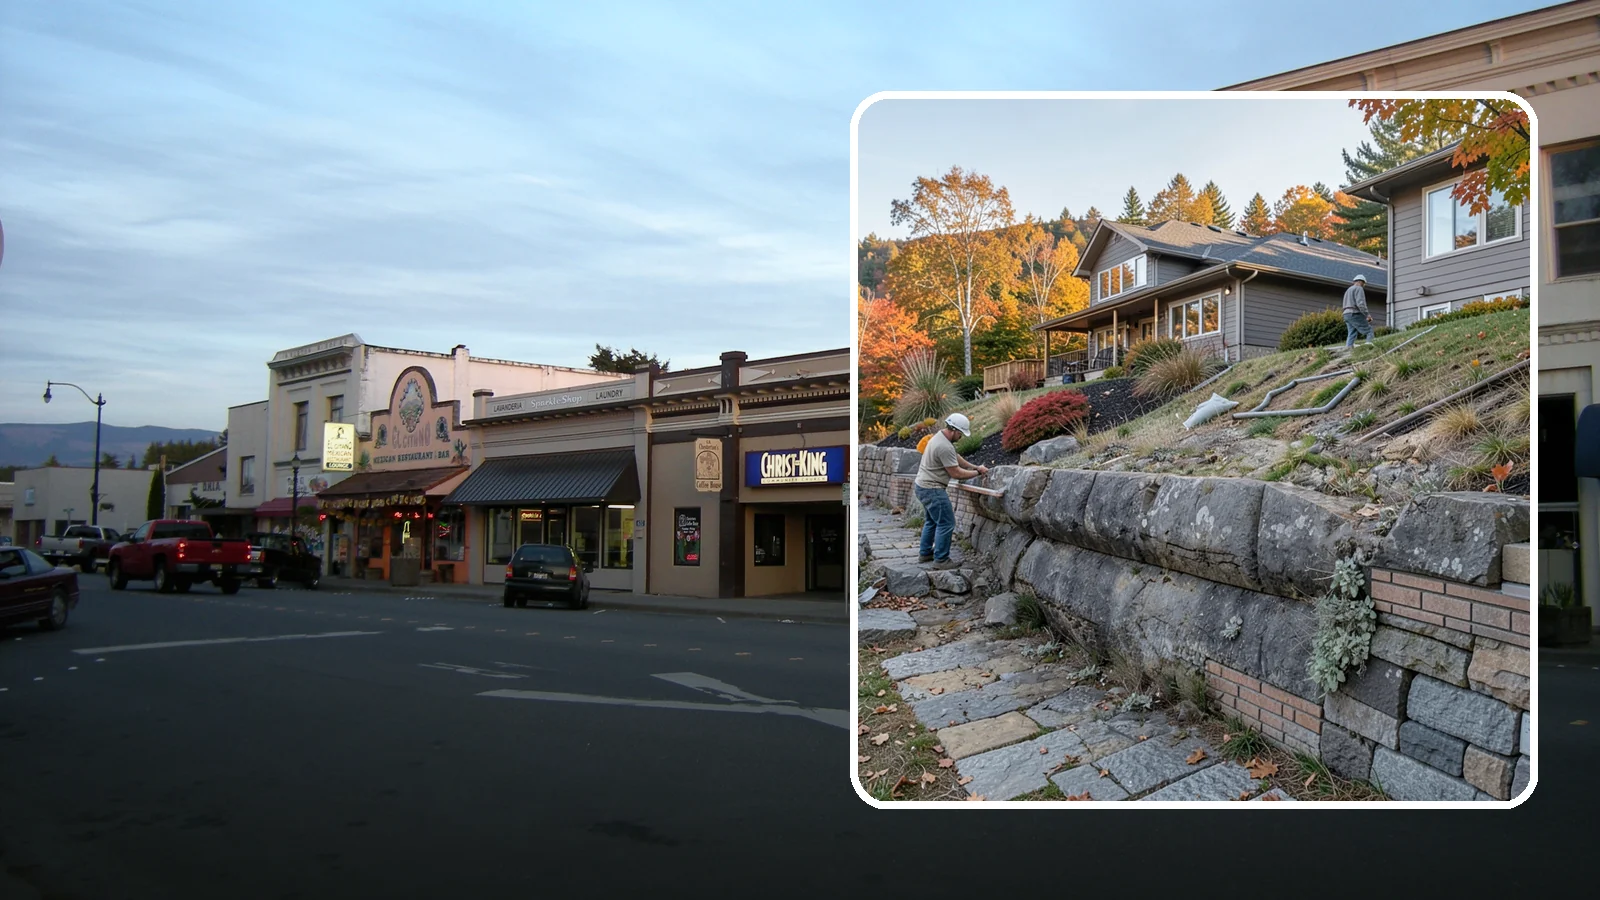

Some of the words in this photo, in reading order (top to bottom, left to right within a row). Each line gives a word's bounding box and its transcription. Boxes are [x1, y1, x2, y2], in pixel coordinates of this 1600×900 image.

[561, 394, 582, 404] Shop
[595, 389, 623, 400] LAUNDRY
[493, 402, 522, 412] LAVANDERIA
[373, 455, 396, 464] MEXICAN
[397, 451, 433, 462] RESTAURANT
[438, 450, 450, 459] BAR
[761, 452, 798, 478] CHRIST
[799, 450, 827, 477] KING
